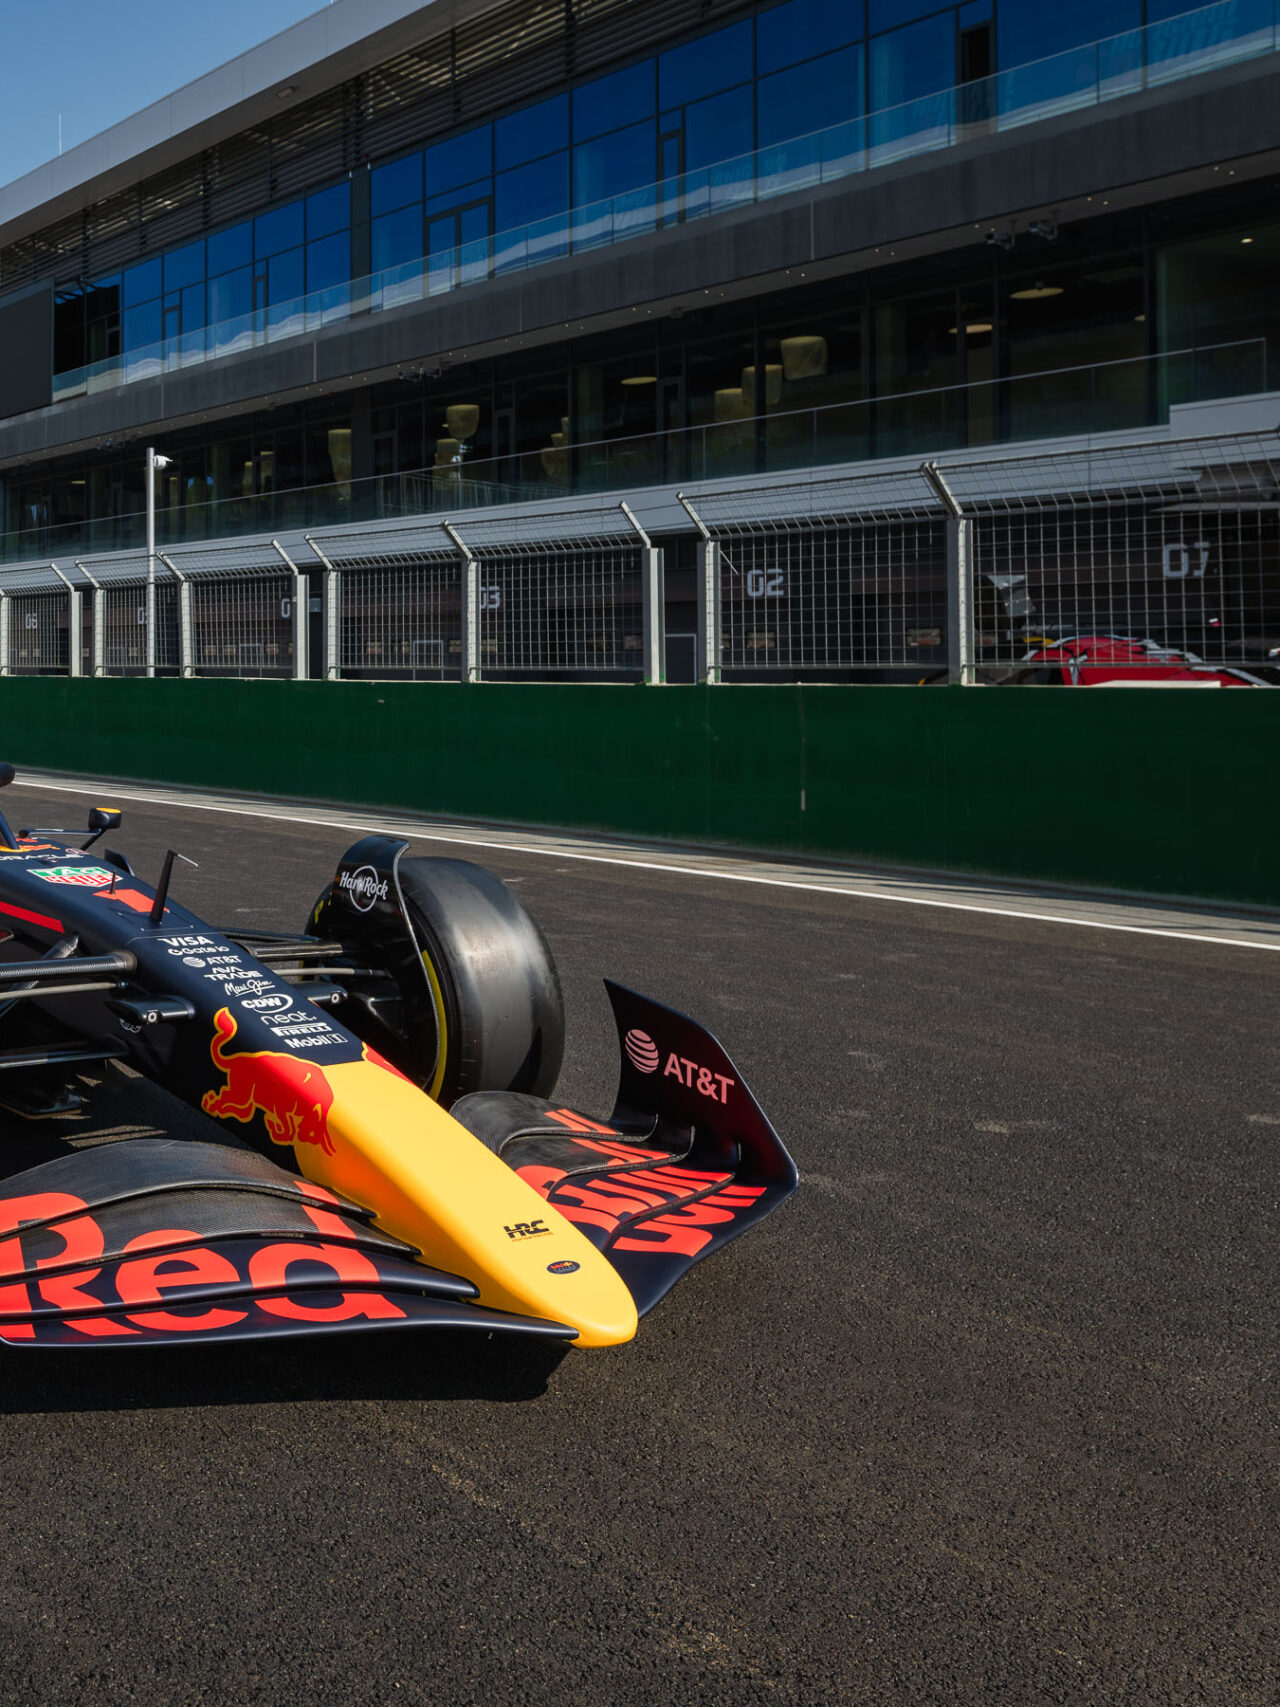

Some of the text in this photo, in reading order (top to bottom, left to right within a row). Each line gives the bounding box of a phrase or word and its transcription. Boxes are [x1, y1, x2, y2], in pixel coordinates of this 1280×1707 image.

[746, 568, 784, 597] 02
[363, 877, 389, 900] Rock
[157, 936, 215, 947] VISA
[207, 955, 242, 965] AT&T
[204, 970, 263, 981] TRADE
[241, 997, 282, 1009] CDW
[270, 1022, 333, 1037] PIRELLI
[284, 1036, 333, 1049] Mobil
[663, 1052, 735, 1105] AT&T
[503, 1219, 550, 1239] HRC
